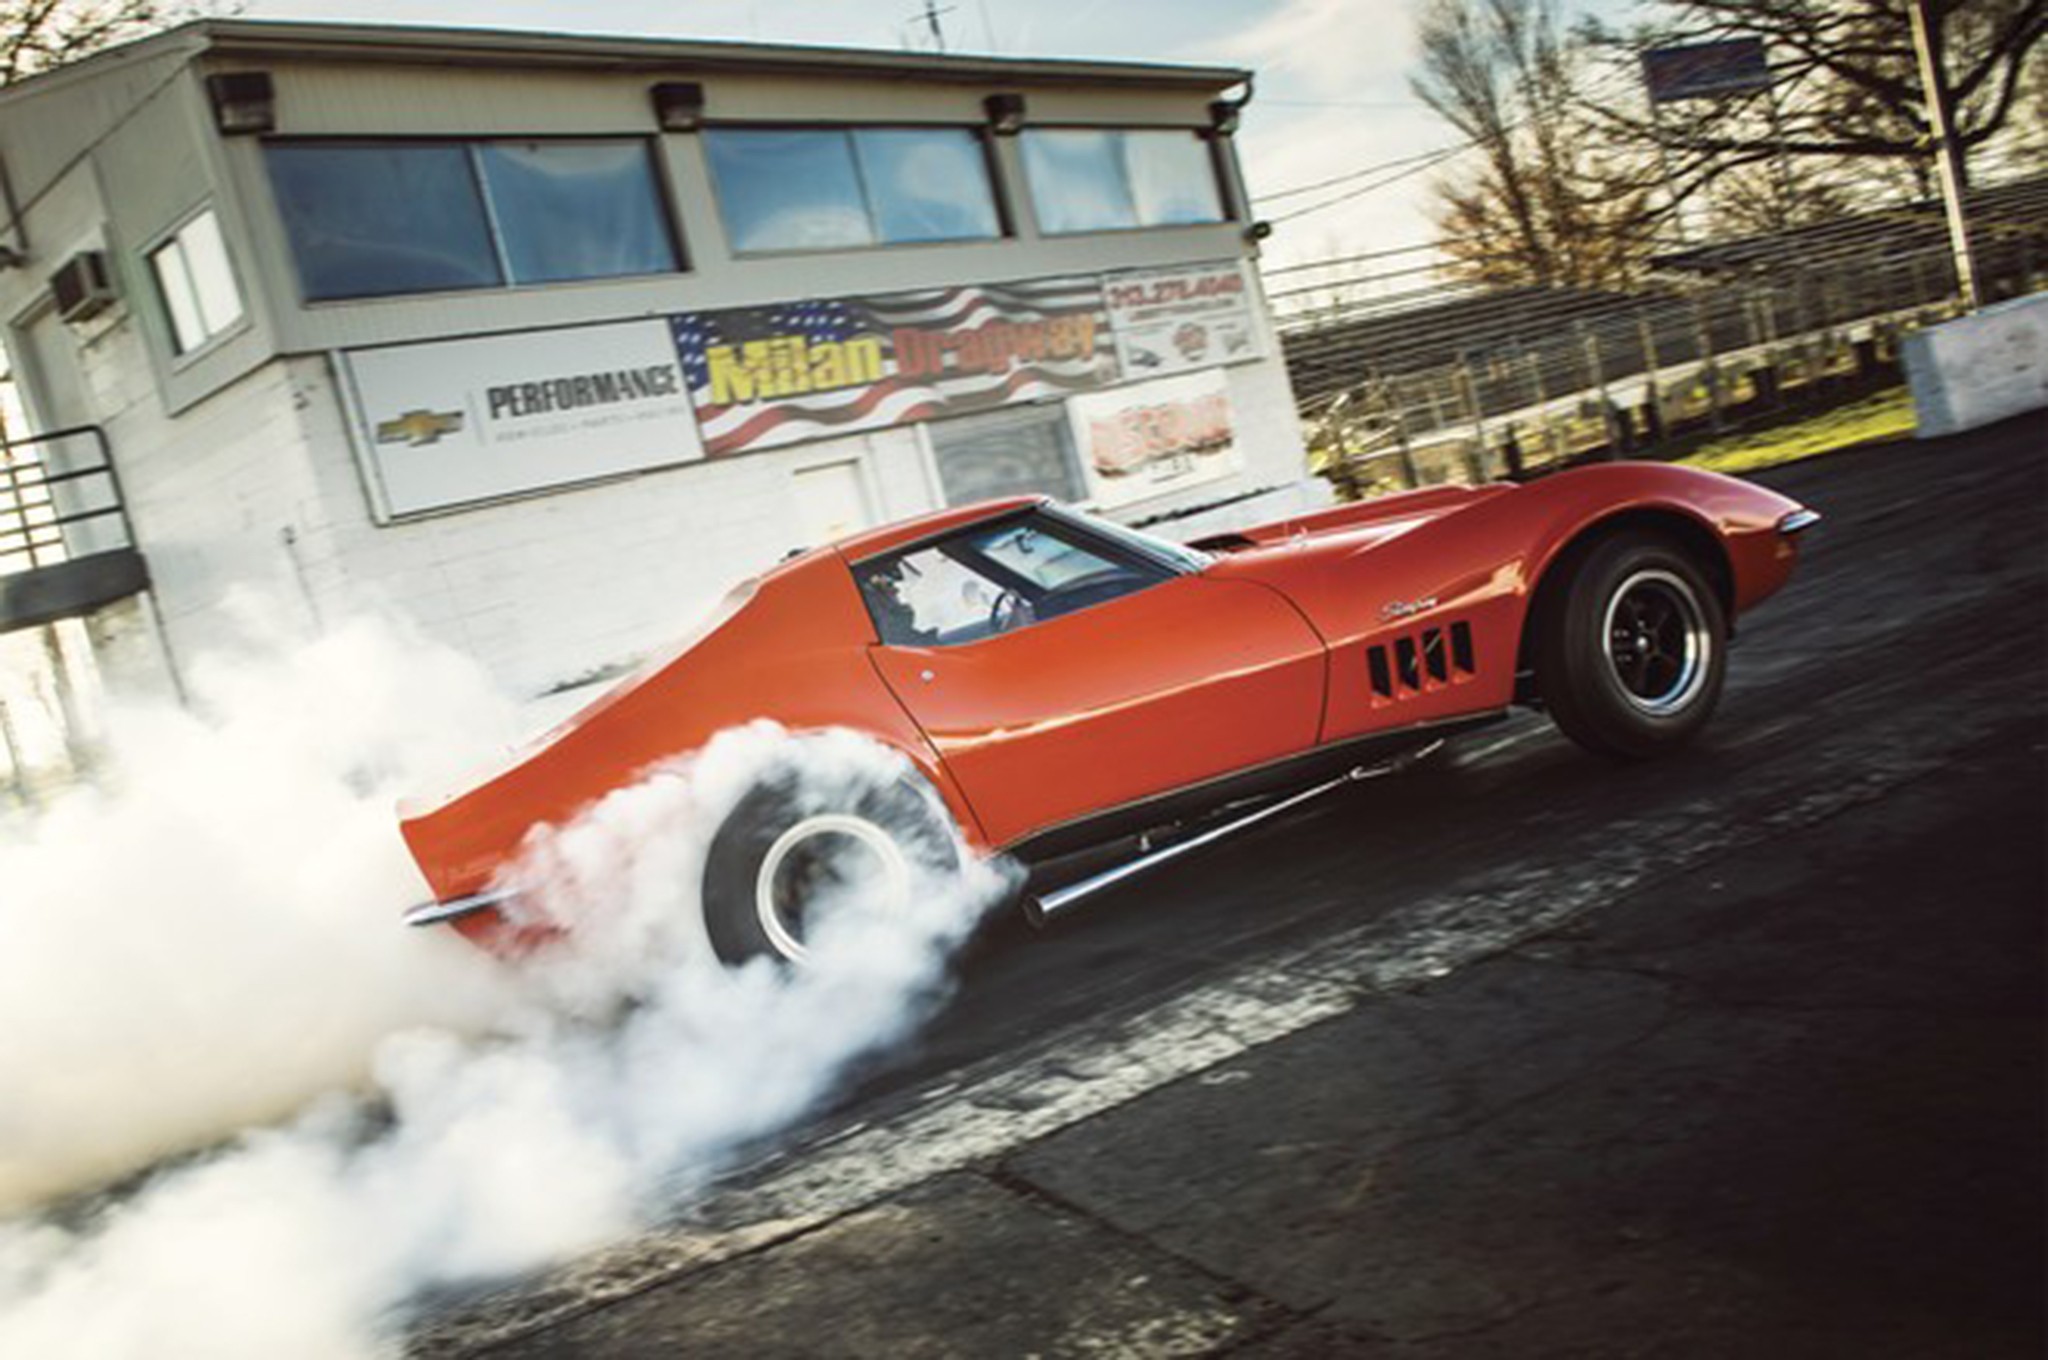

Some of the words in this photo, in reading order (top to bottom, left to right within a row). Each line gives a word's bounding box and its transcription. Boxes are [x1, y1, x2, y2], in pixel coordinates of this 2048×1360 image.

[486, 363, 680, 420] PERFORMANCE
[706, 335, 884, 405] Milan
[893, 313, 1094, 375] Dragway
